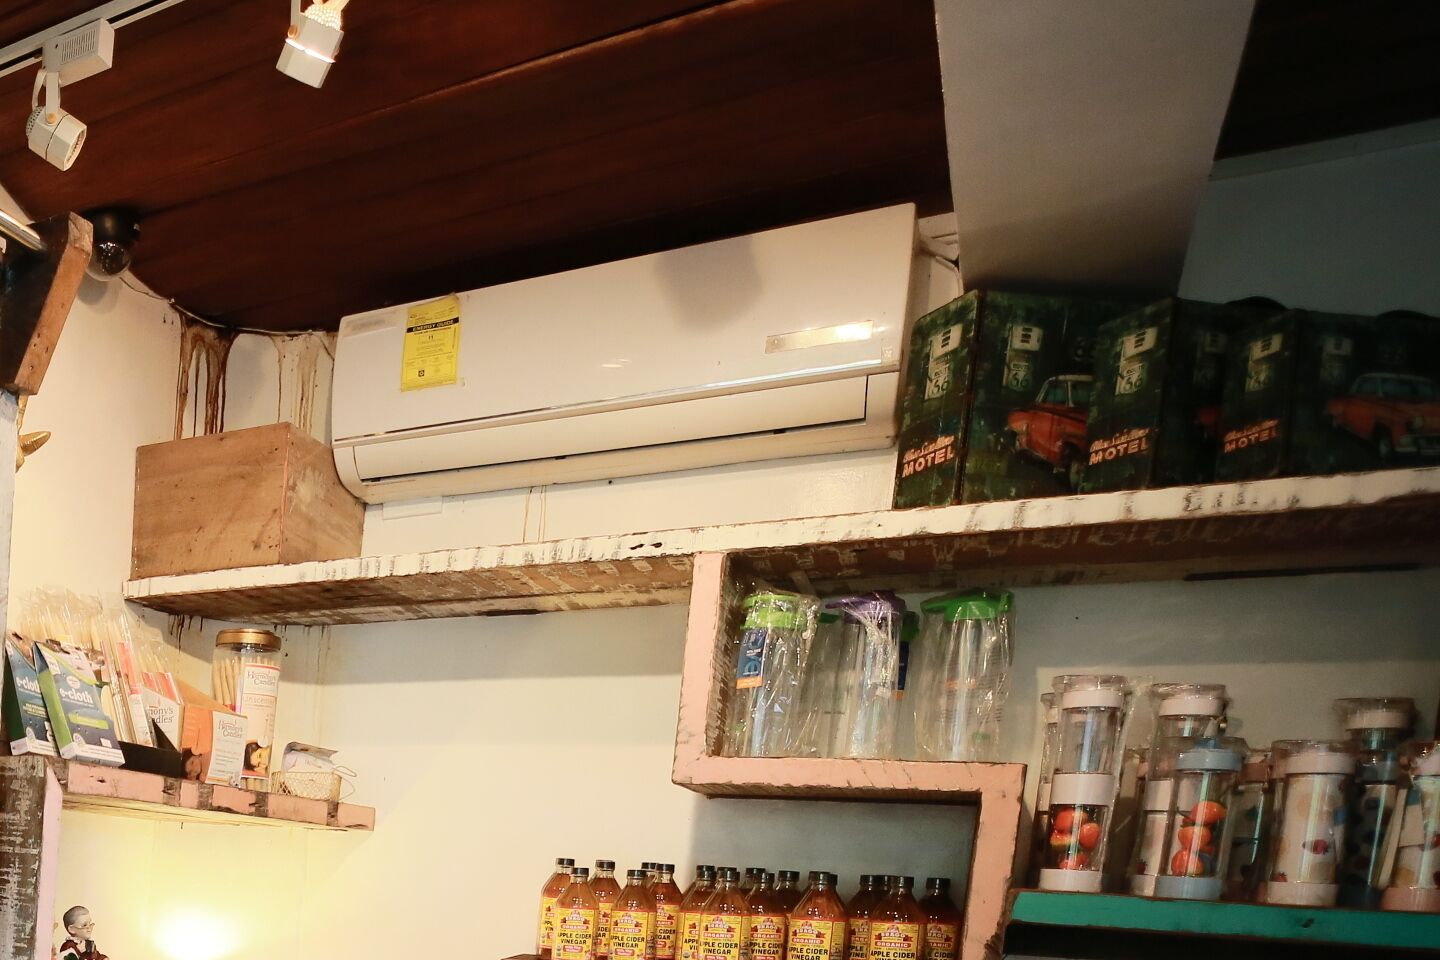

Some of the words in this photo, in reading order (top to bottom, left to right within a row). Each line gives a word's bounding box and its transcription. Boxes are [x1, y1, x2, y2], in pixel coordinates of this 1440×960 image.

[902, 449, 956, 478] MOTEL
[1089, 439, 1149, 466] MOTEL
[60, 687, 93, 704] e-cloth
